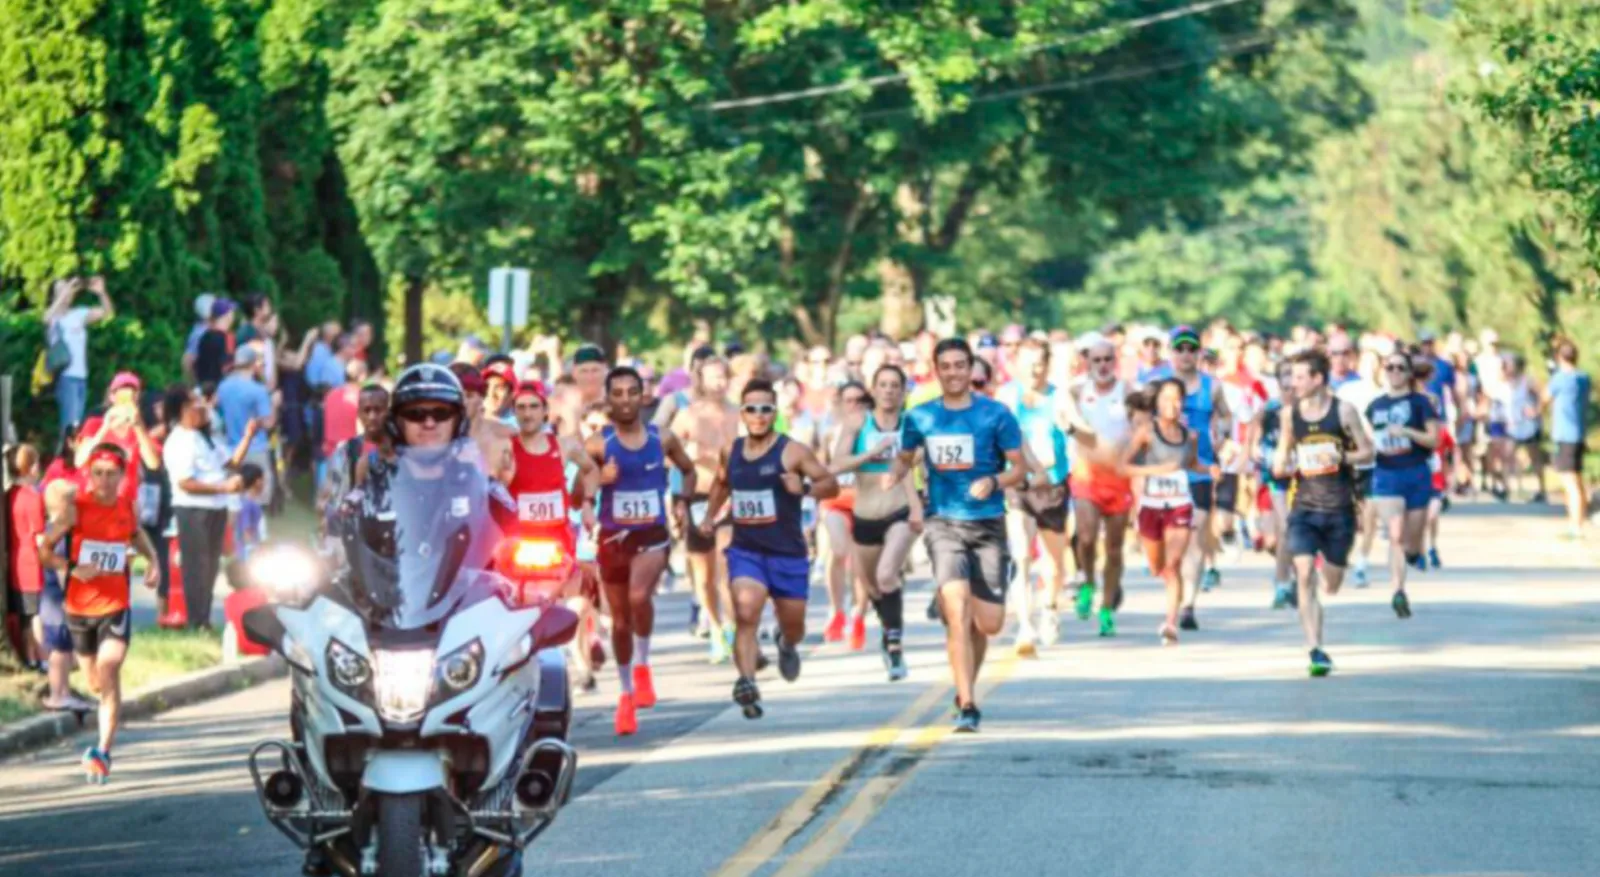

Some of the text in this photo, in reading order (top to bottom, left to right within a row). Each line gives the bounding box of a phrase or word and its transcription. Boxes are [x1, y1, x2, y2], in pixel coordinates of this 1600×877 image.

[936, 445, 963, 463] 752
[529, 502, 554, 520] 501
[623, 500, 650, 518] 513
[737, 500, 764, 517] 894
